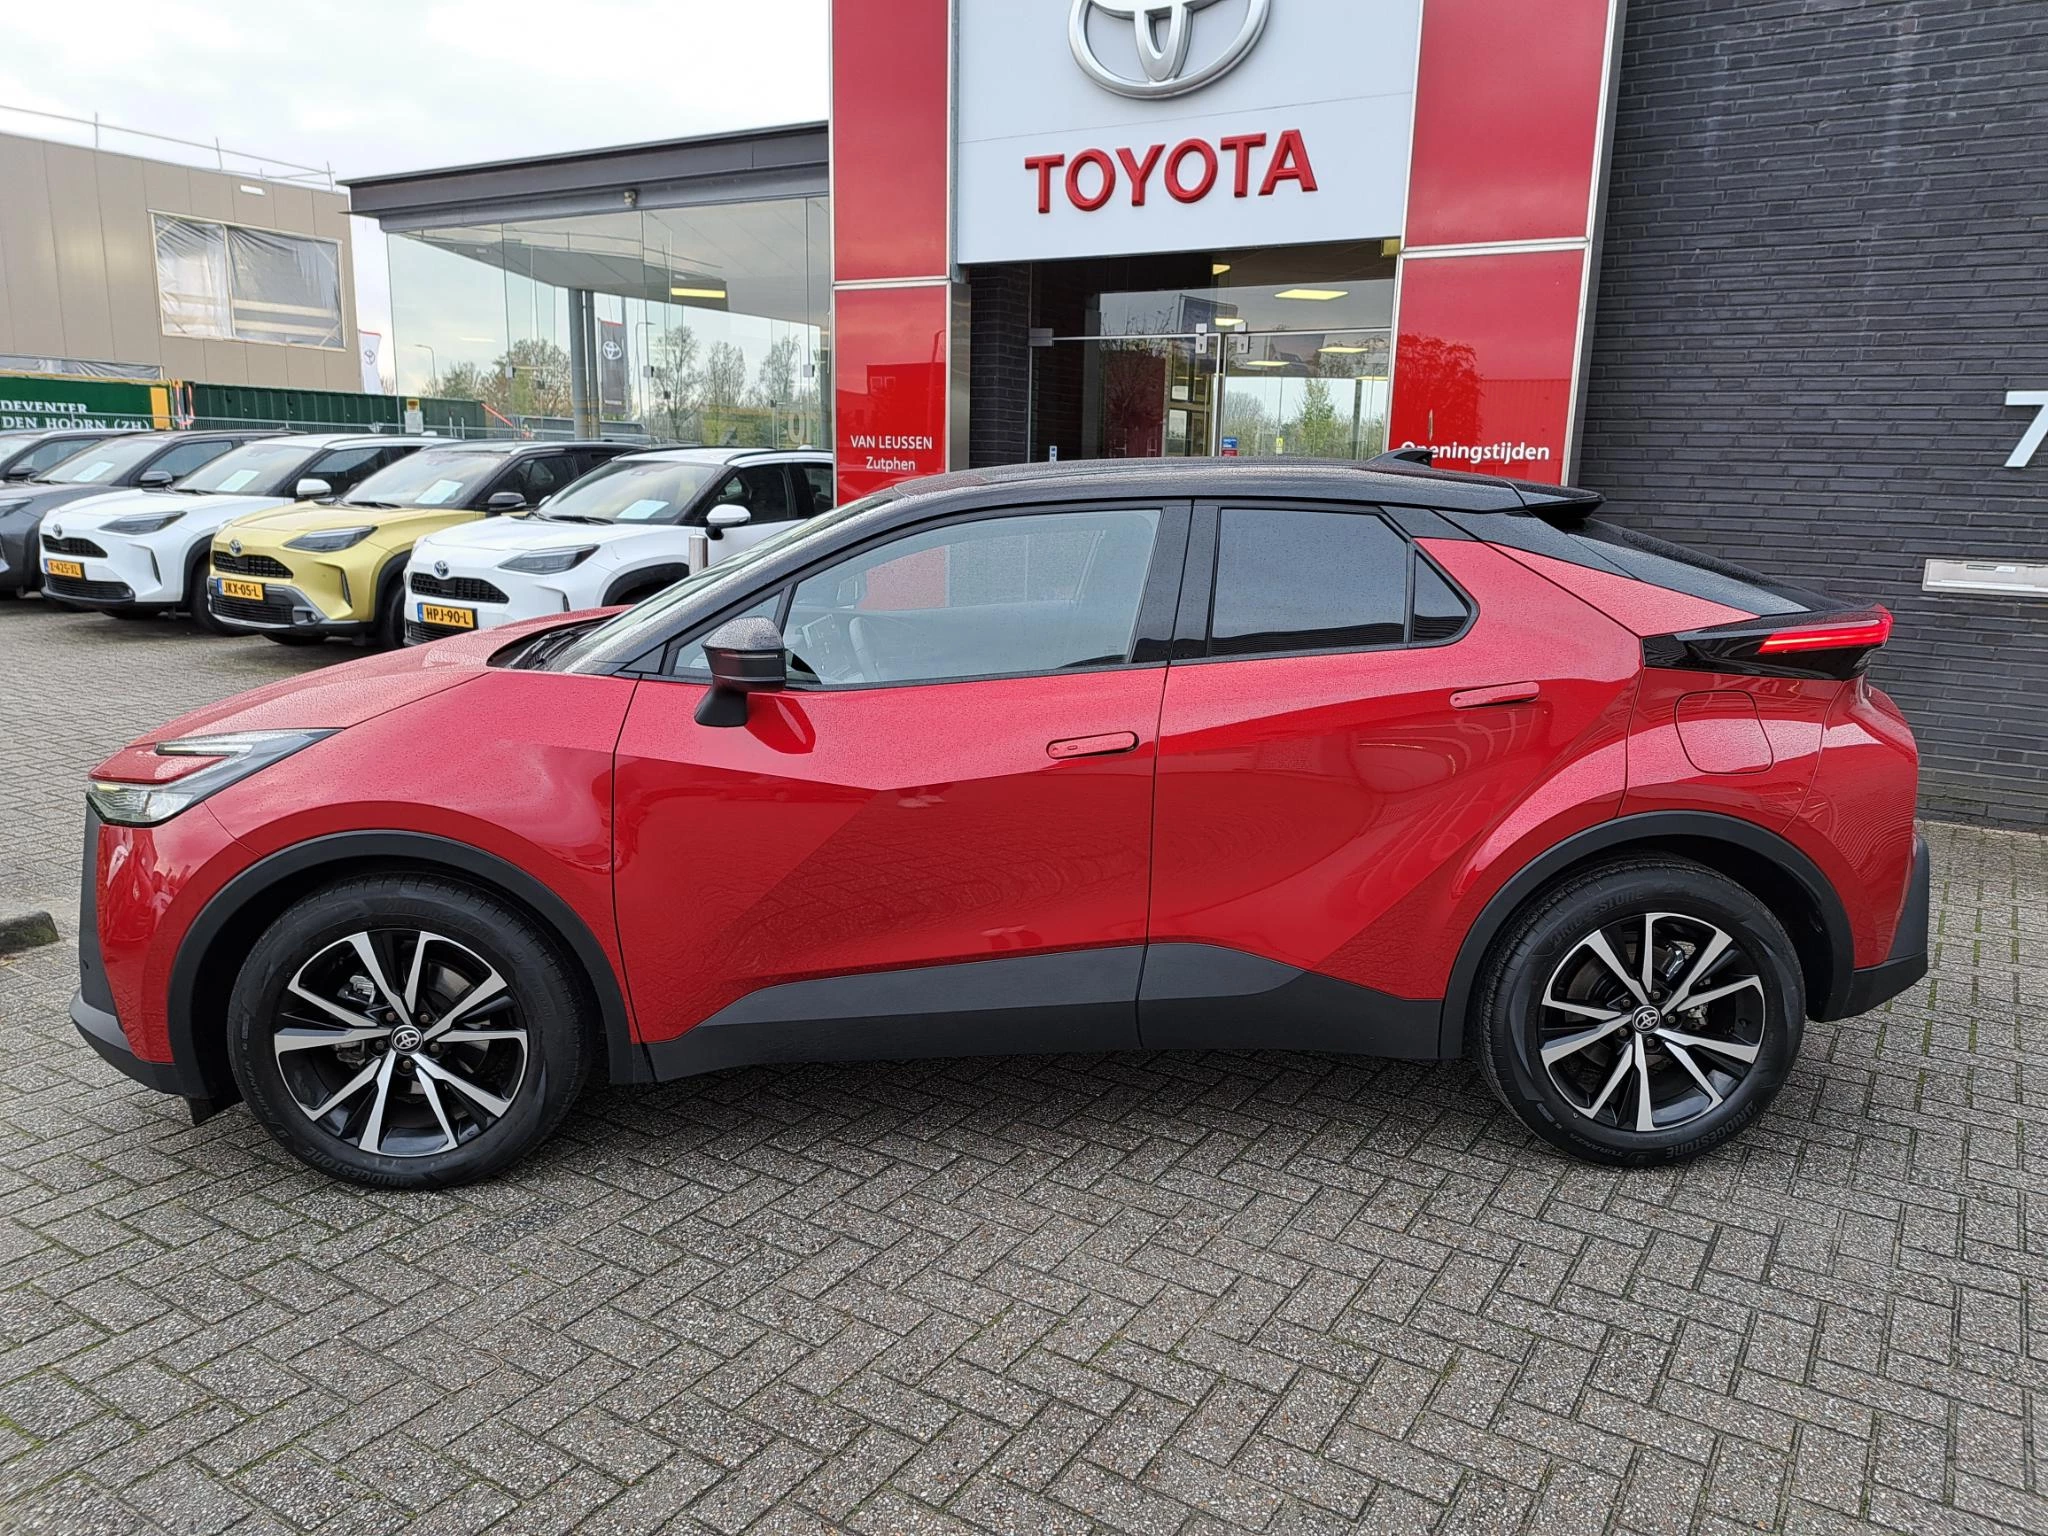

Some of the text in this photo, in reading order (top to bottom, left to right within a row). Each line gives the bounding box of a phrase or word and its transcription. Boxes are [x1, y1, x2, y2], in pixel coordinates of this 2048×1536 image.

[1025, 129, 1318, 214] TOYOTA
[0, 400, 88, 414] DEVENTER
[2, 416, 37, 429] DEN
[46, 417, 107, 430] HOORN
[2004, 391, 2048, 468] 7
[850, 435, 933, 450] VAN LEUSSEN
[1400, 440, 1550, 465] eningstijden
[866, 456, 916, 473] Zutphen
[224, 581, 261, 598] JKX-05-L
[426, 607, 470, 625] HPJ-90-L
